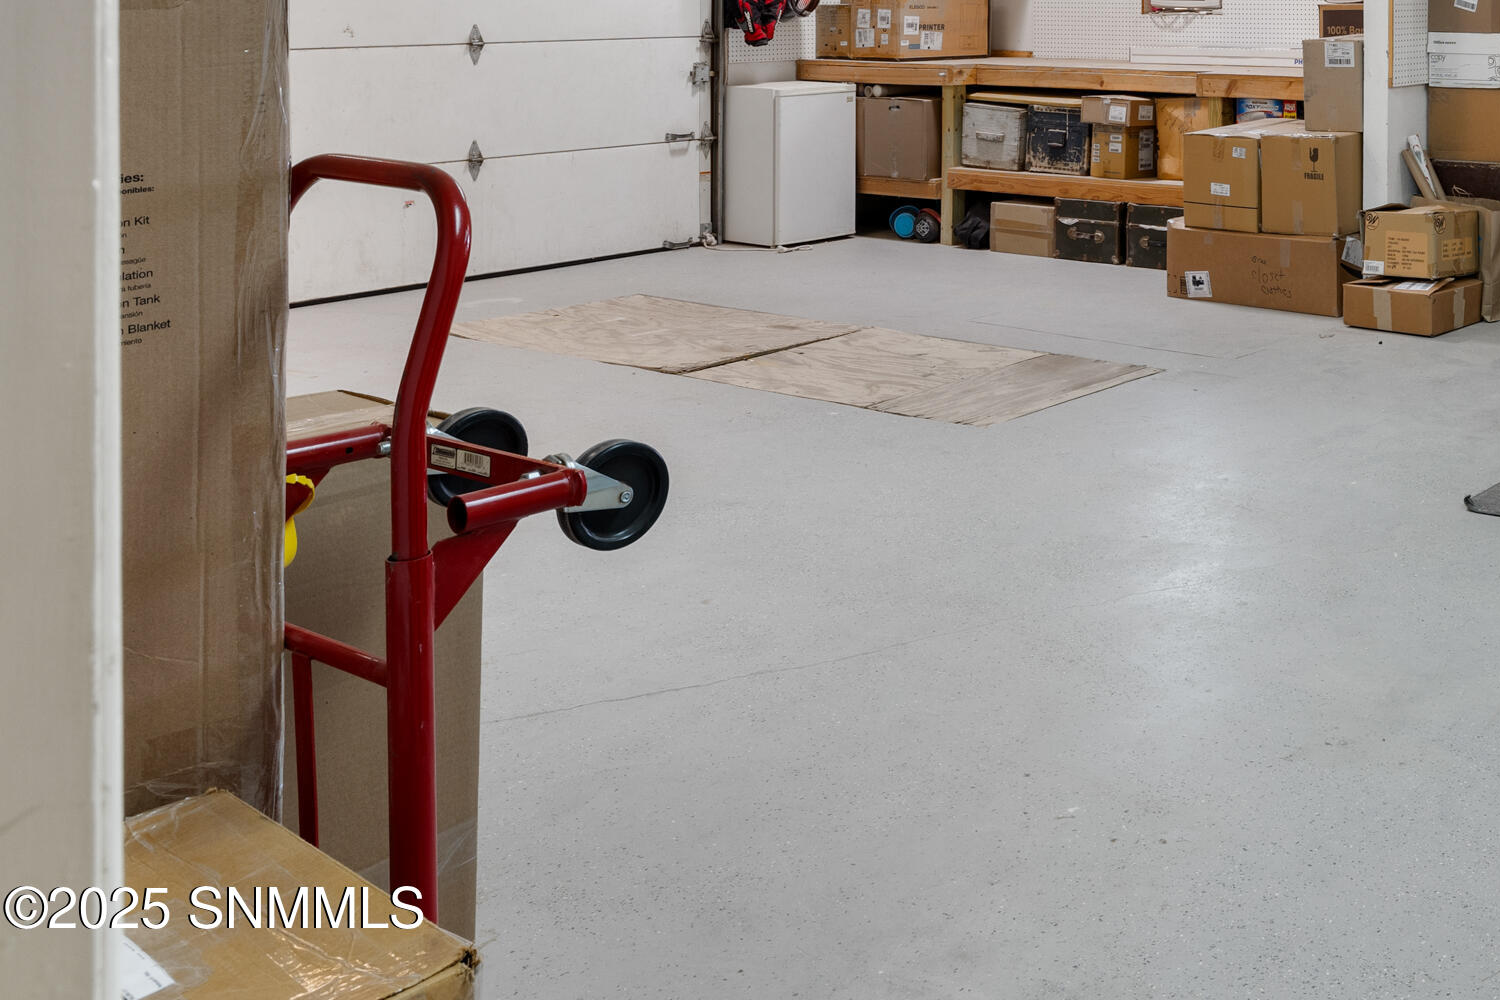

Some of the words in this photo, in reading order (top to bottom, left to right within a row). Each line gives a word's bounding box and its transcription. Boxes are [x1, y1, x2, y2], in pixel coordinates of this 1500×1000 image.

[1327, 26, 1347, 36] 100%
[134, 216, 150, 226] Kit
[133, 294, 160, 306] Tank
[128, 320, 171, 334] Blanket
